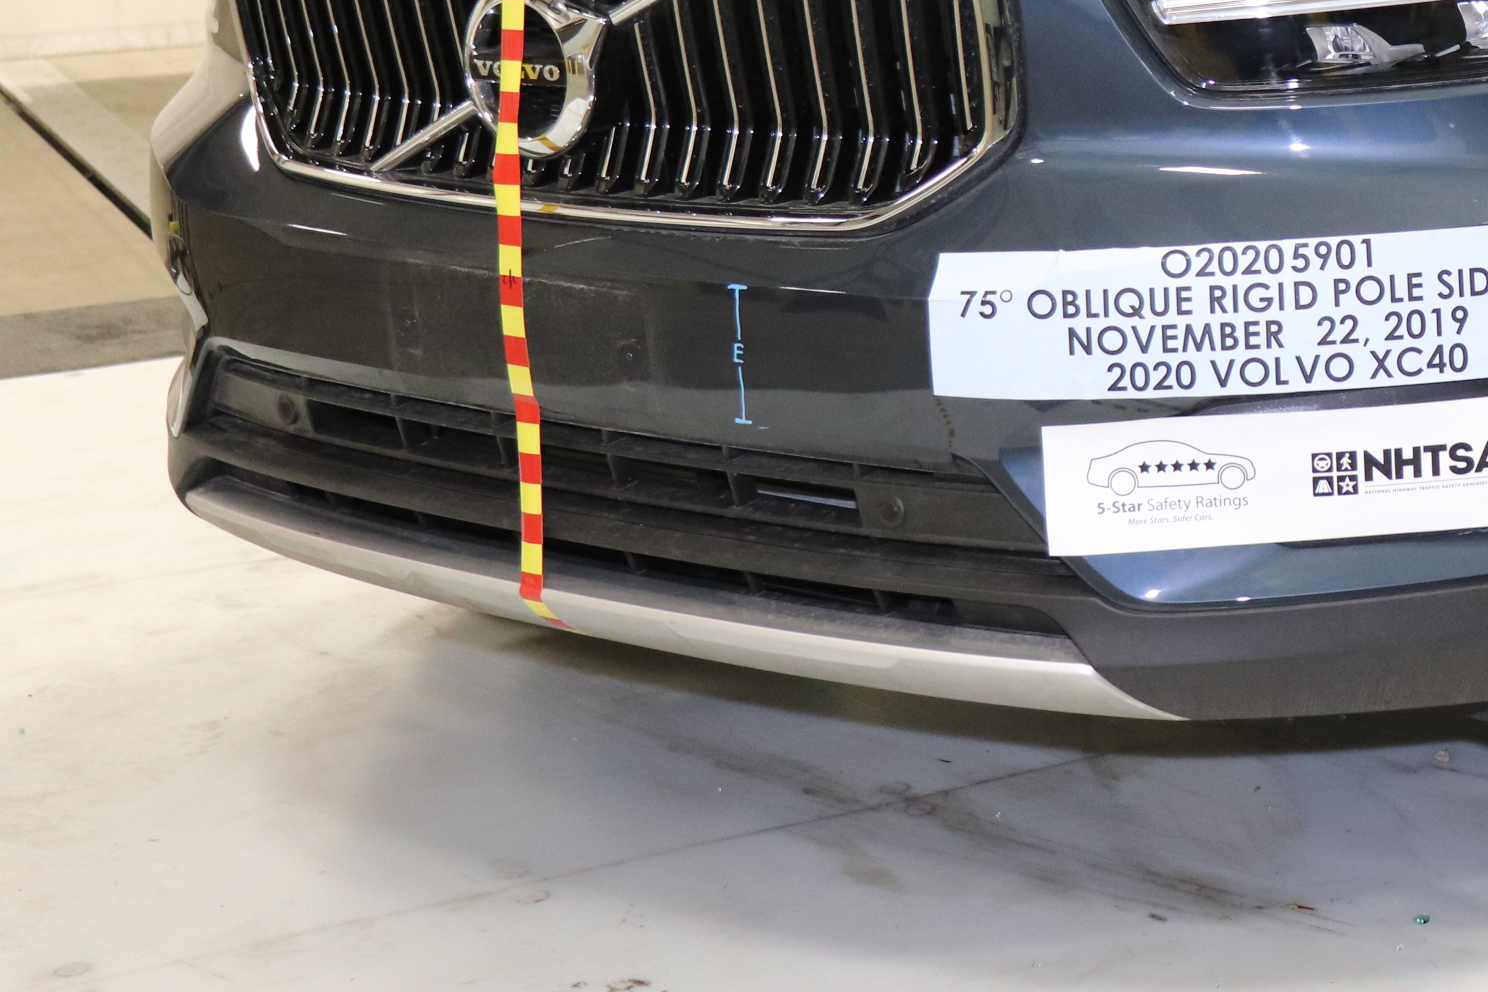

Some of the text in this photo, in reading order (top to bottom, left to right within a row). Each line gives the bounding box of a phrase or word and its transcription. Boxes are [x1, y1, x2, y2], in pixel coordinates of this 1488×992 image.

[1160, 238, 1373, 279] O20205901
[959, 289, 1014, 320] 75°
[1026, 285, 1193, 320] OBLIQUE
[1208, 280, 1318, 315] RIGID
[1333, 271, 1424, 308] POLE
[1067, 305, 1469, 356] NOVEMBER 22, 2019
[733, 343, 744, 364] E
[1106, 342, 1470, 392] 2020 VOLVO XC40
[1097, 495, 1249, 515] 5-Star Safety Ratings
[1127, 513, 1214, 526] More Stars. Safer Cars.
